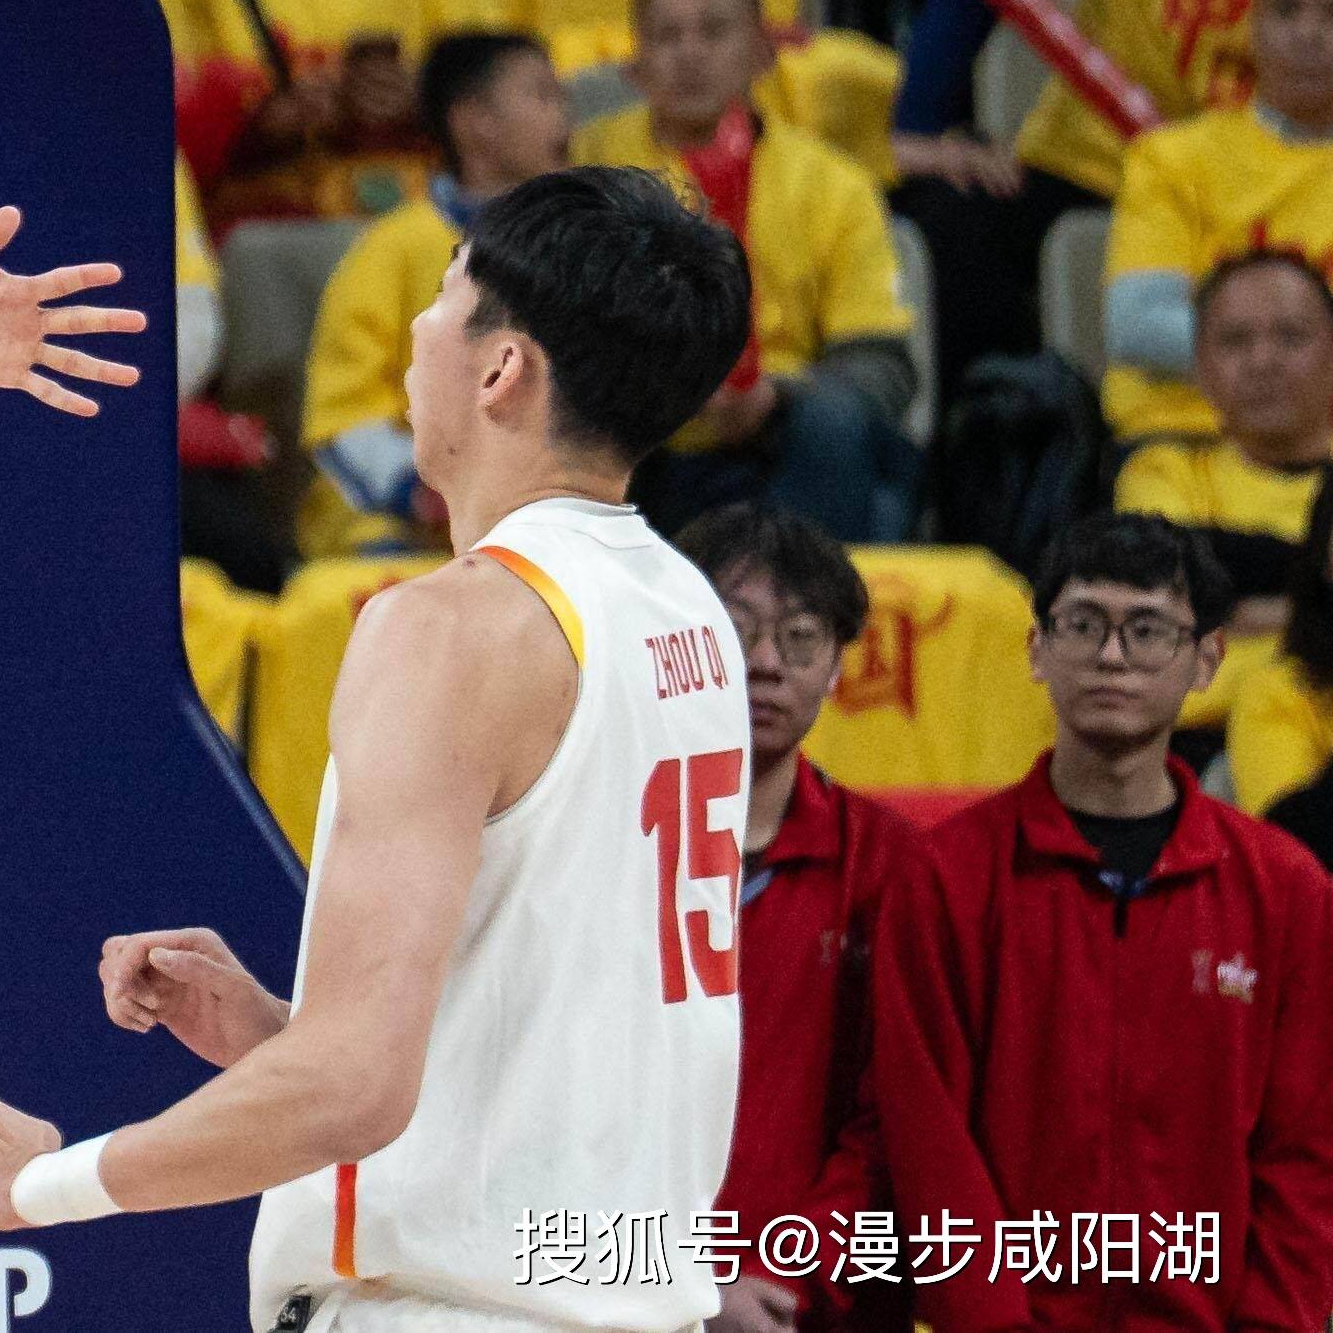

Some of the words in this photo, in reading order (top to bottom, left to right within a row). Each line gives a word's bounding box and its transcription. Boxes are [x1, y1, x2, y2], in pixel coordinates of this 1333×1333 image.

[645, 628, 704, 700] ZHOU
[702, 625, 729, 690] QI
[640, 748, 743, 1005] 15
